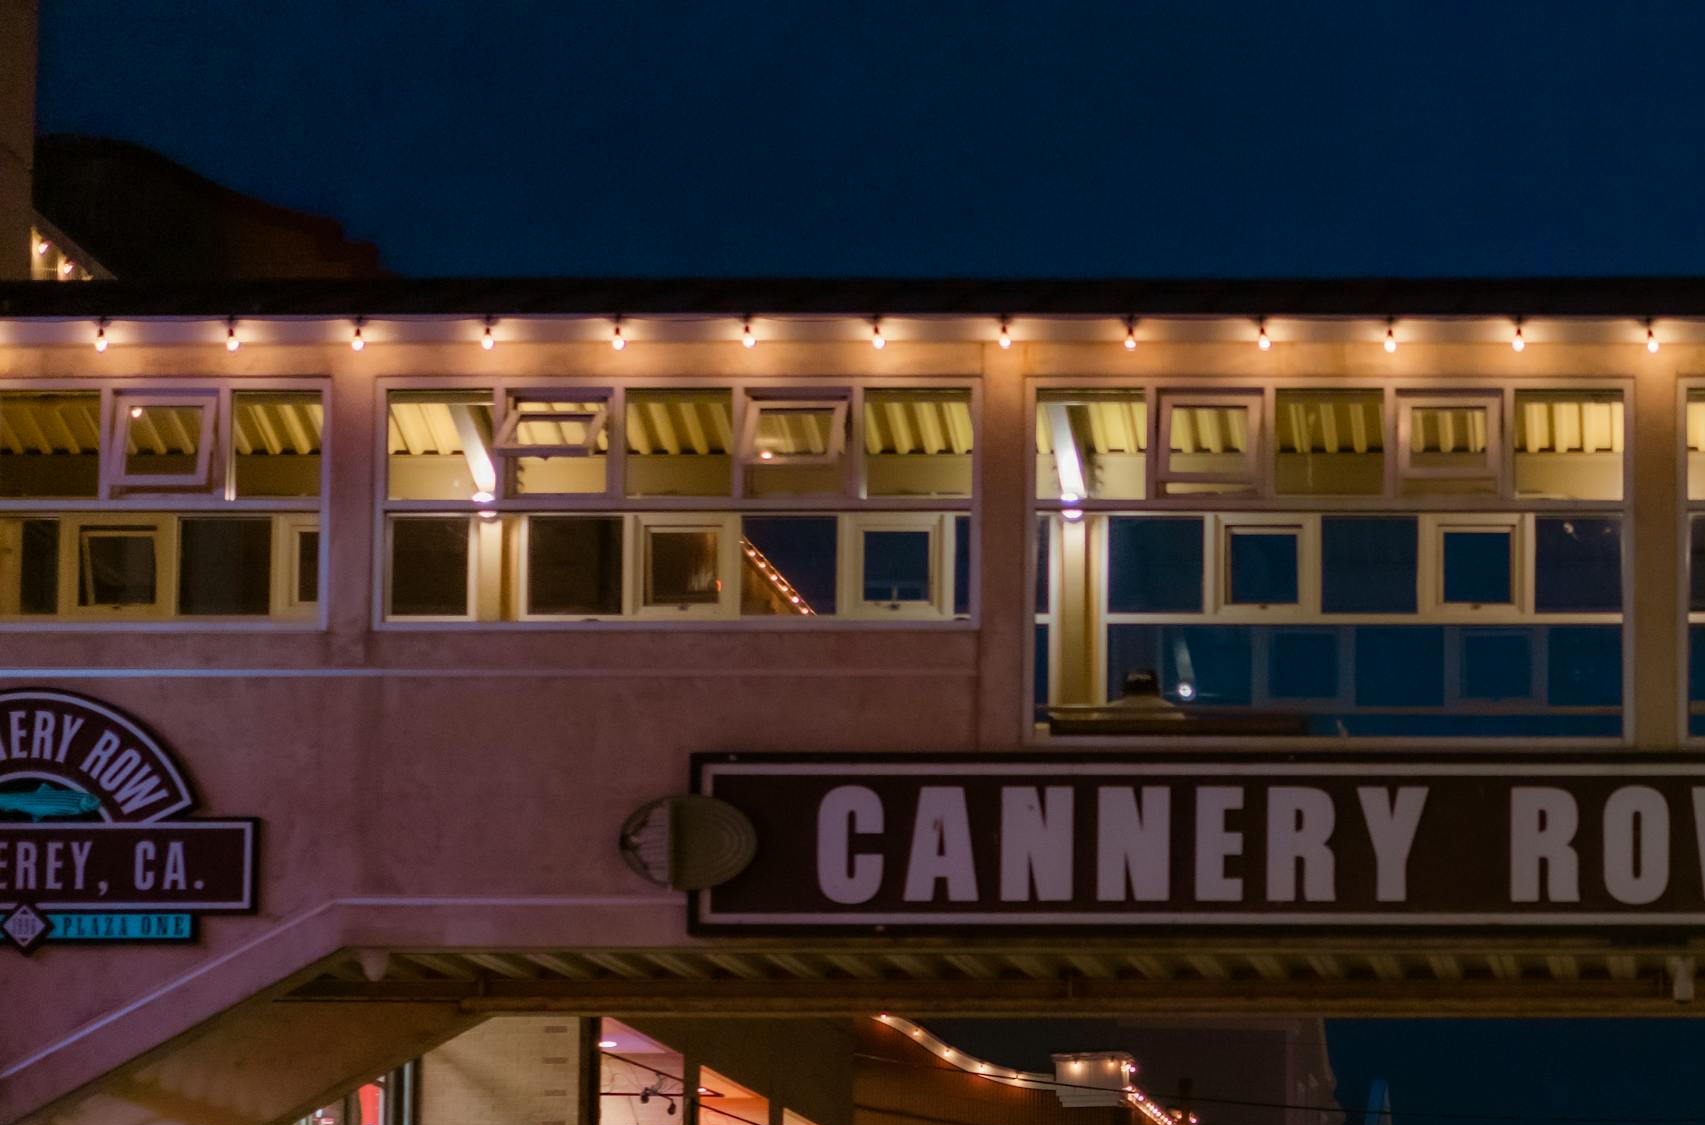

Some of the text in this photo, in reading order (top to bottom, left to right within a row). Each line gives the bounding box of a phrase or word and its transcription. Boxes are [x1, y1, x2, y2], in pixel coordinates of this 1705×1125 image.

[0, 710, 170, 815] ERY ROW
[133, 840, 205, 892] CA.
[816, 785, 1429, 904] CANNERY
[63, 916, 128, 937] PLAZA
[141, 916, 185, 937] ONE
